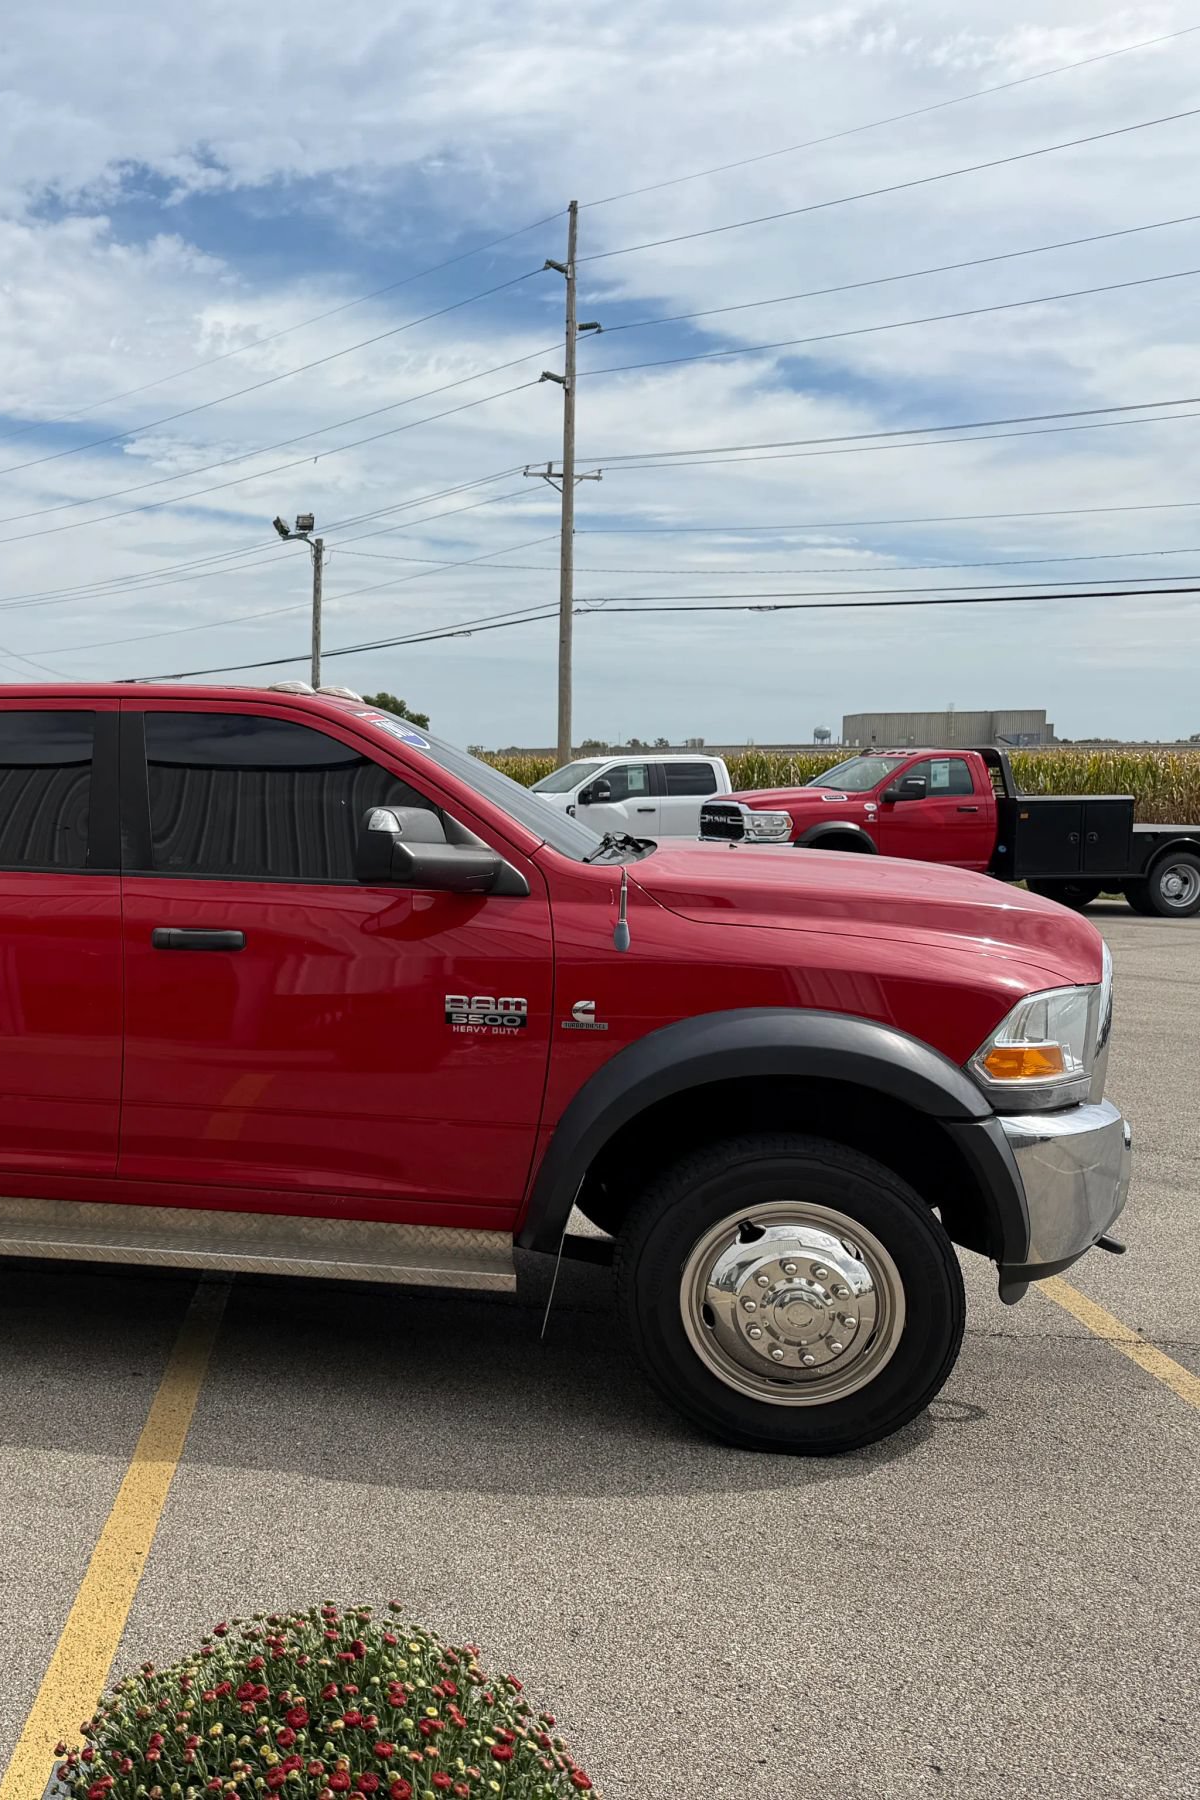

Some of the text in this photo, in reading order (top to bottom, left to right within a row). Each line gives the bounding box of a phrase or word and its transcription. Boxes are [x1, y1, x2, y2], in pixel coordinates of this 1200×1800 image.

[445, 994, 528, 1016] RAM
[451, 1013, 521, 1026] 5500
[452, 1025, 520, 1035] HEAVY DUTY
